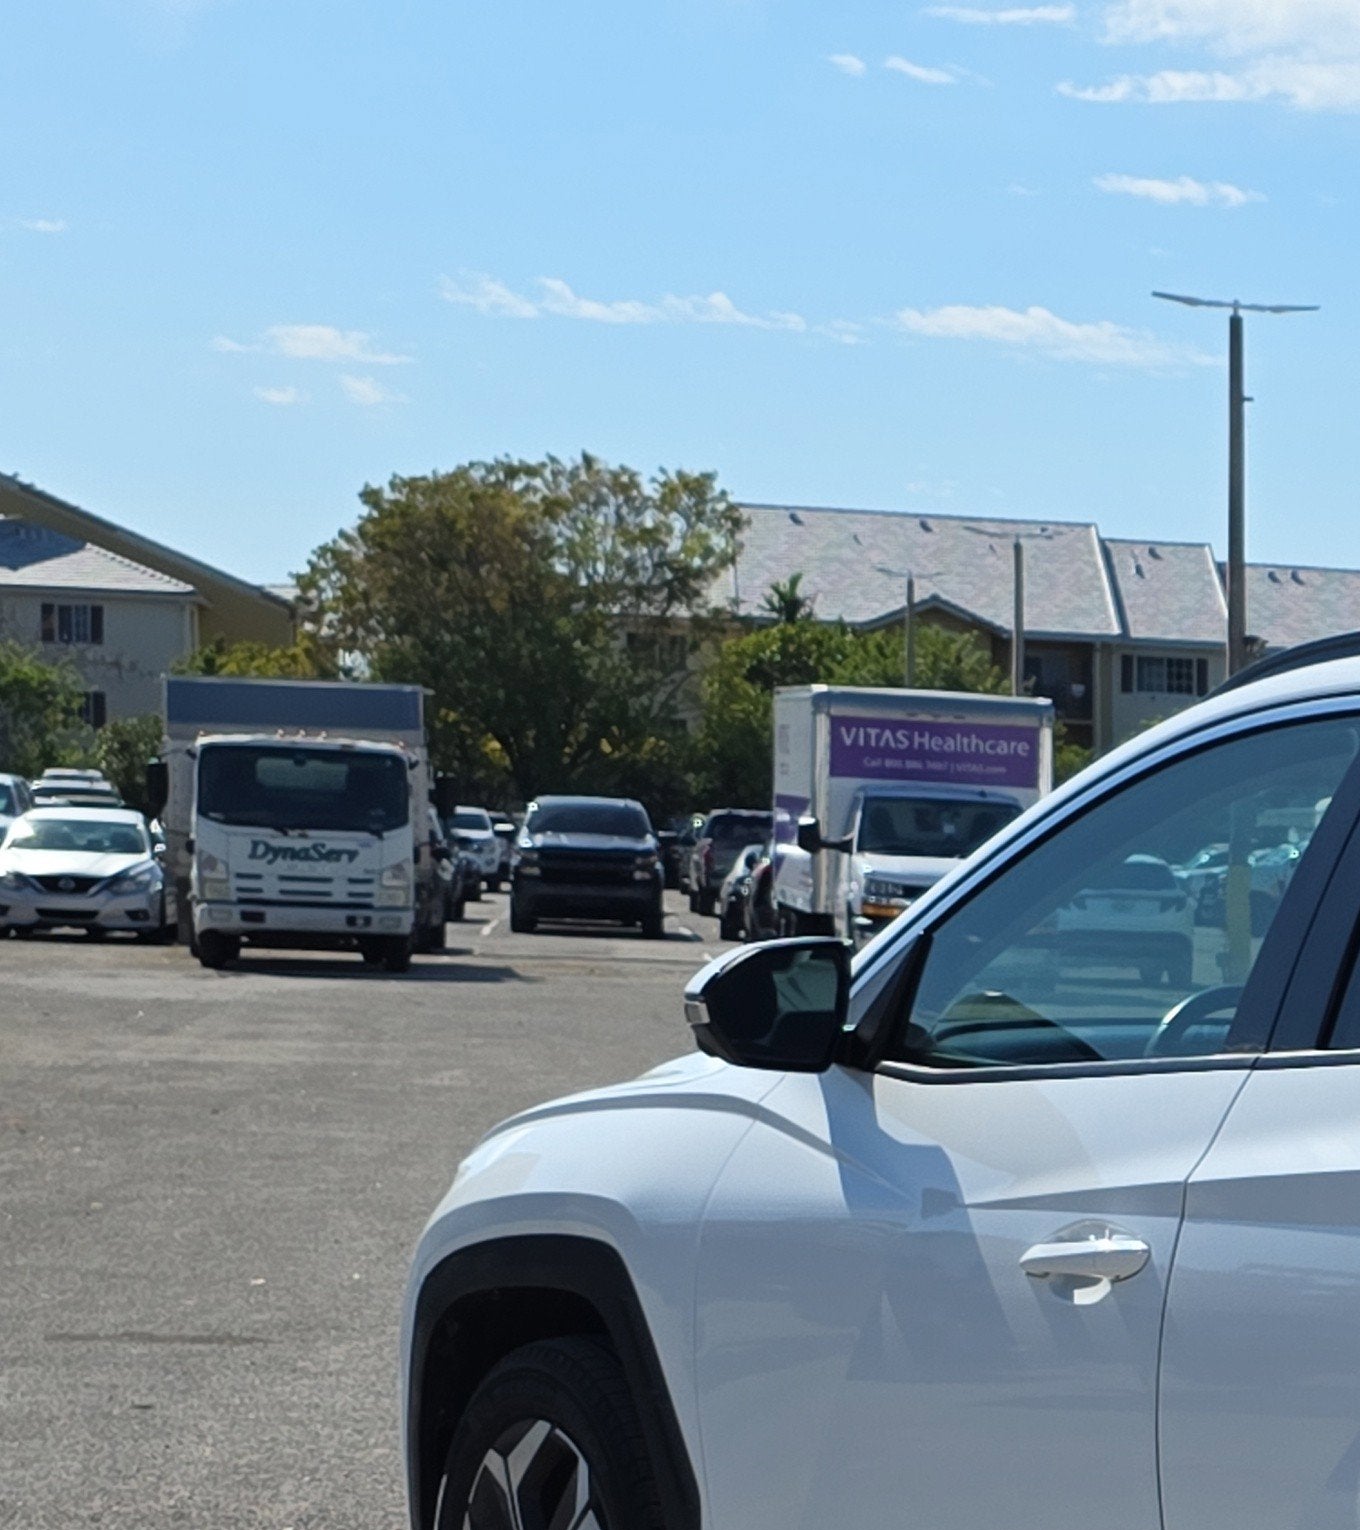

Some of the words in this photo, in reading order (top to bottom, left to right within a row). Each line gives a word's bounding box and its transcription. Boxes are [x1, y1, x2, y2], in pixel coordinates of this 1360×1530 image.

[840, 726, 909, 750] VITAS
[913, 730, 1031, 757] Healthcare
[247, 839, 360, 865] DynaServ
